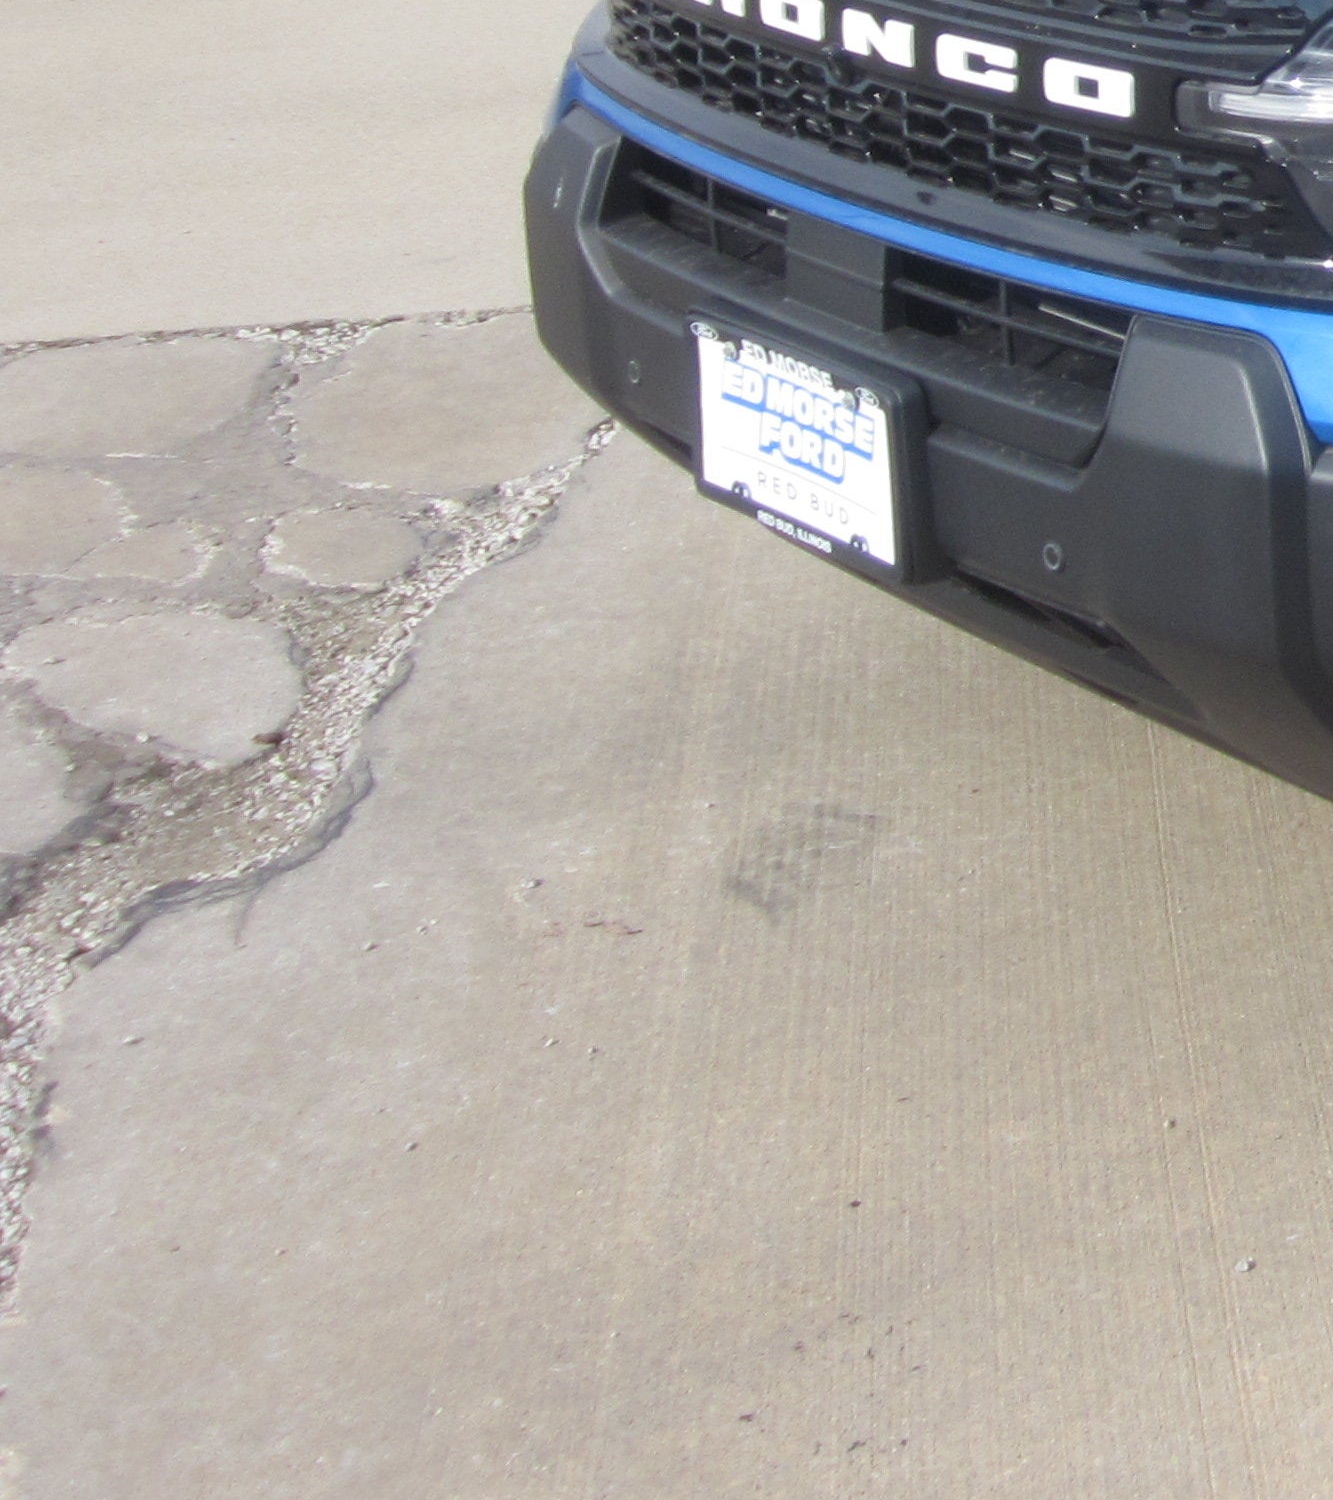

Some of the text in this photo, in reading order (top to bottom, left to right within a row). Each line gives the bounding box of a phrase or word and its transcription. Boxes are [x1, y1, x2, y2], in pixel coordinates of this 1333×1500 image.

[740, 338, 834, 389] ED MORSE
[722, 357, 875, 461] ED MORSE
[759, 410, 846, 485] FORD
[757, 470, 849, 525] RED BUD
